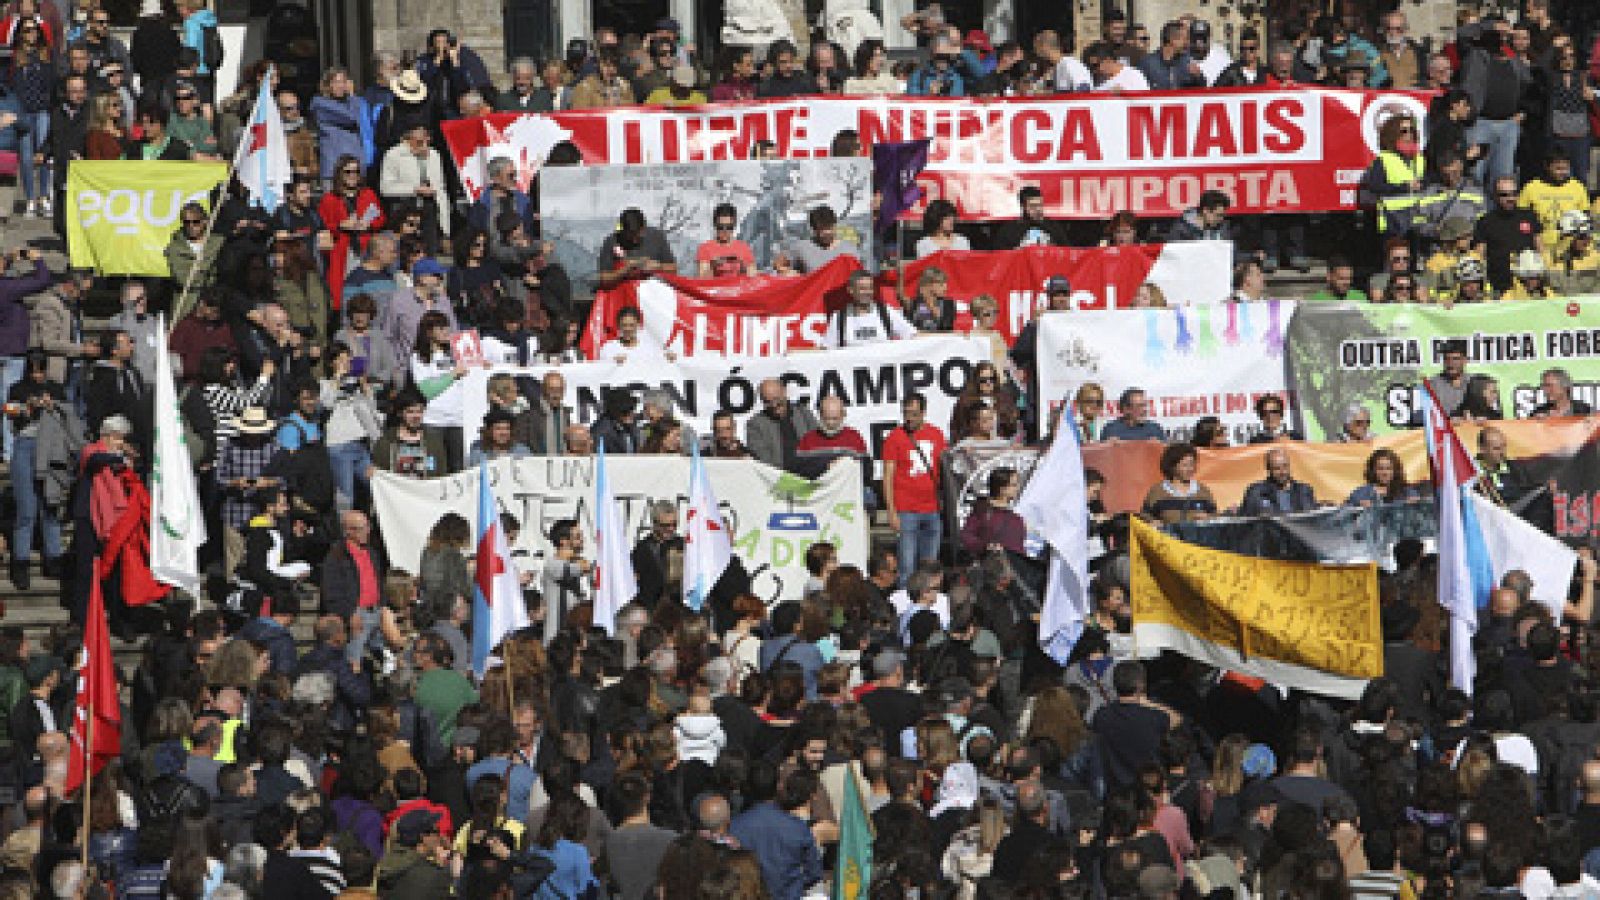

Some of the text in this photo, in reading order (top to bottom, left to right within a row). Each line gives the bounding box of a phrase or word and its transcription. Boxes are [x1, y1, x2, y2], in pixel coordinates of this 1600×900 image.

[1127, 98, 1307, 162] MAIS
[1061, 170, 1301, 216] IMPORTA
[1342, 341, 1421, 367] OUTRA
[780, 357, 972, 408] CAMPO
